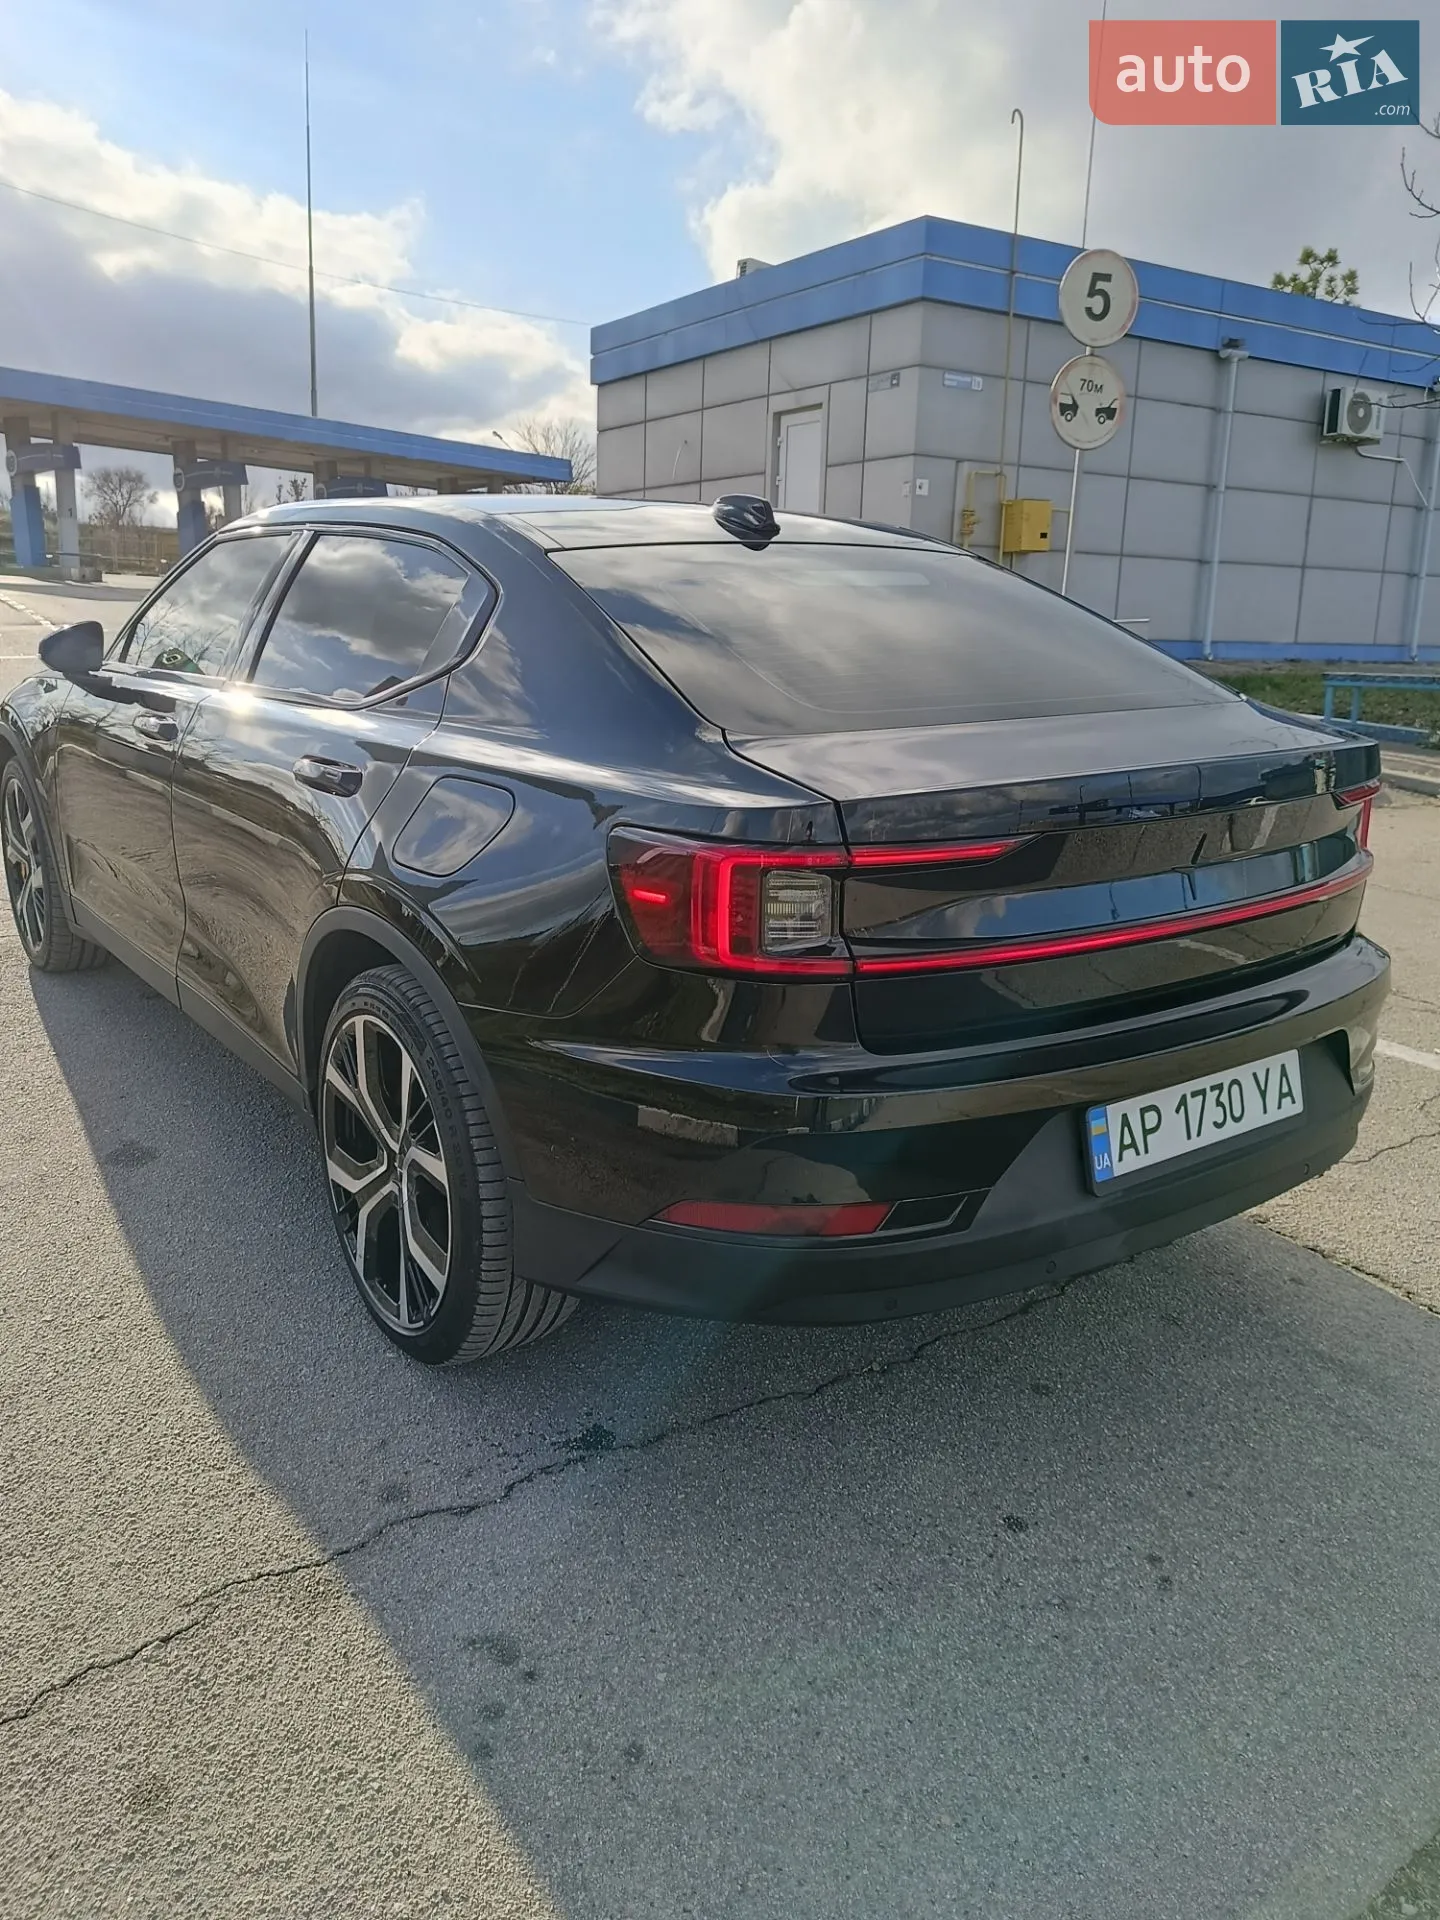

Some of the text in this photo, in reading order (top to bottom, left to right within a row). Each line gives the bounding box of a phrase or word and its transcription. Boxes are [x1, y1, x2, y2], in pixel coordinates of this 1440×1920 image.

[1084, 272, 1112, 322] 5
[1118, 1063, 1297, 1163] AP 1730 YA
[1094, 1153, 1112, 1171] UA
